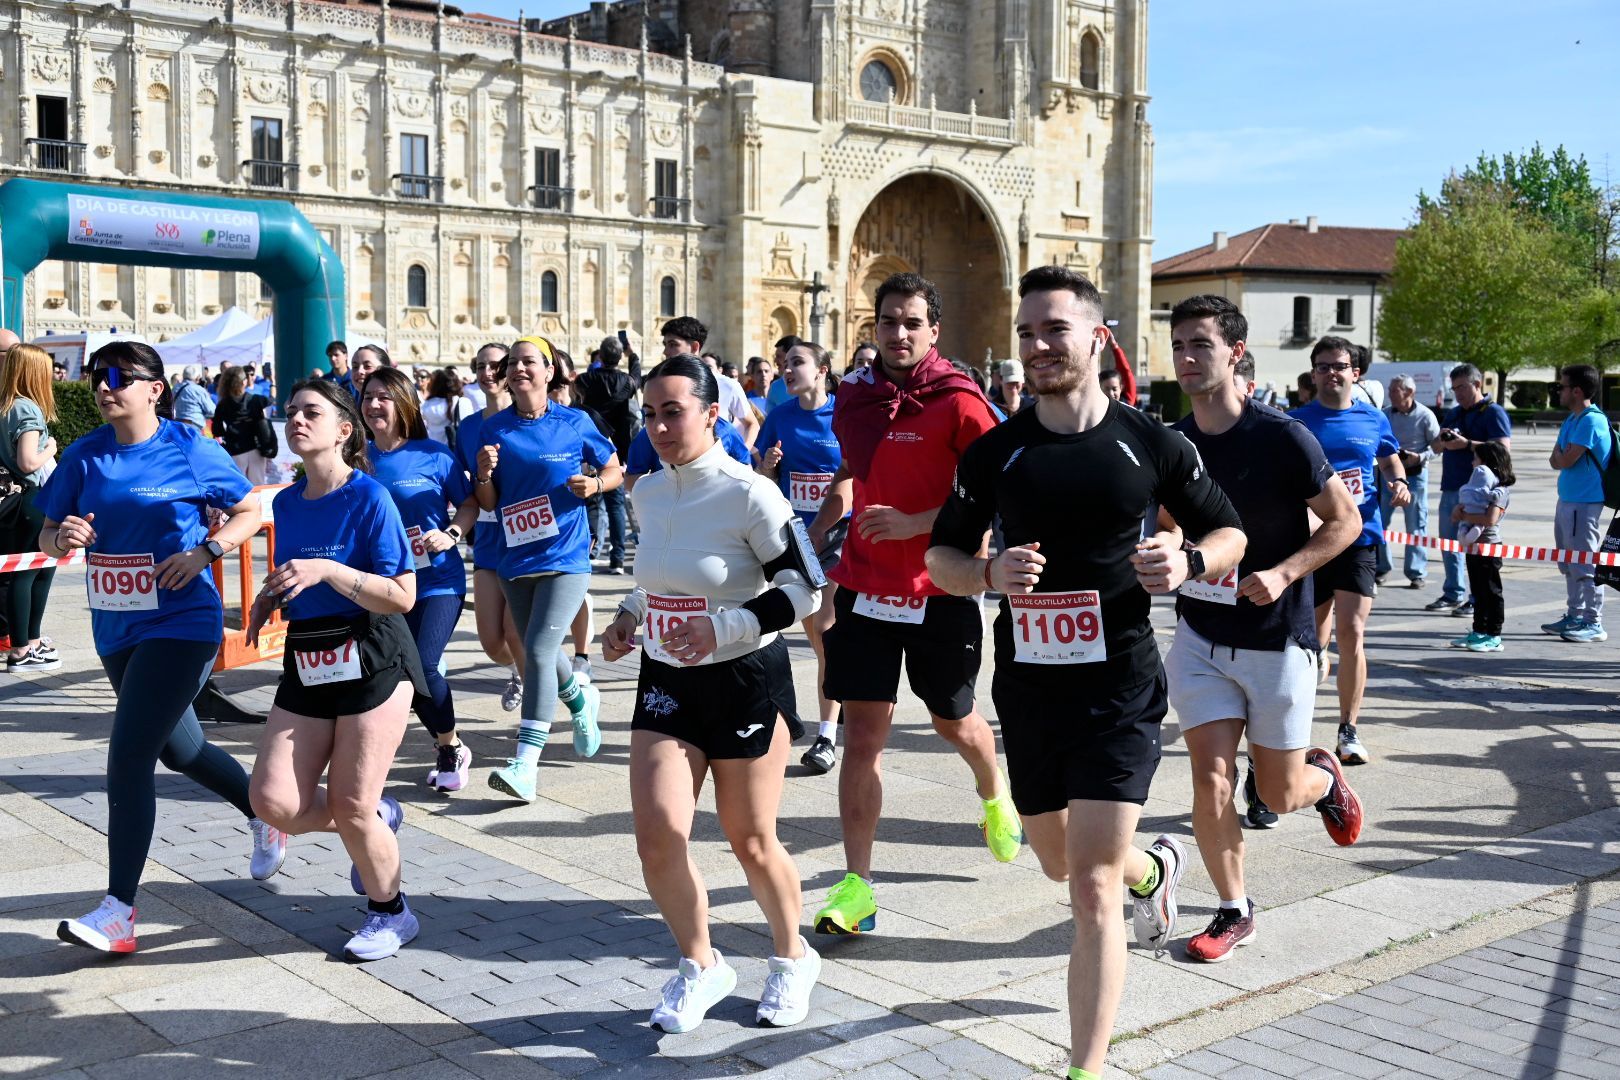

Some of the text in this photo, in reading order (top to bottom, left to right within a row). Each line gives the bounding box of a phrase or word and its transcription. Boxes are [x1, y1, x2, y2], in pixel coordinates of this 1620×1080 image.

[76, 198, 254, 226] DÍA DE CASTILLA Y LEÓN
[75, 235, 98, 243] Castilla
[94, 231, 114, 239] Junta
[218, 230, 251, 243] Plena
[217, 241, 250, 250] inclusión
[506, 508, 553, 535] 1005
[91, 569, 153, 595] 1090
[656, 600, 678, 608] CASTILLA
[684, 600, 703, 608] LEÓN
[1013, 596, 1025, 604] DÍA
[1017, 611, 1099, 644] 1109
[296, 638, 354, 669] 1087
